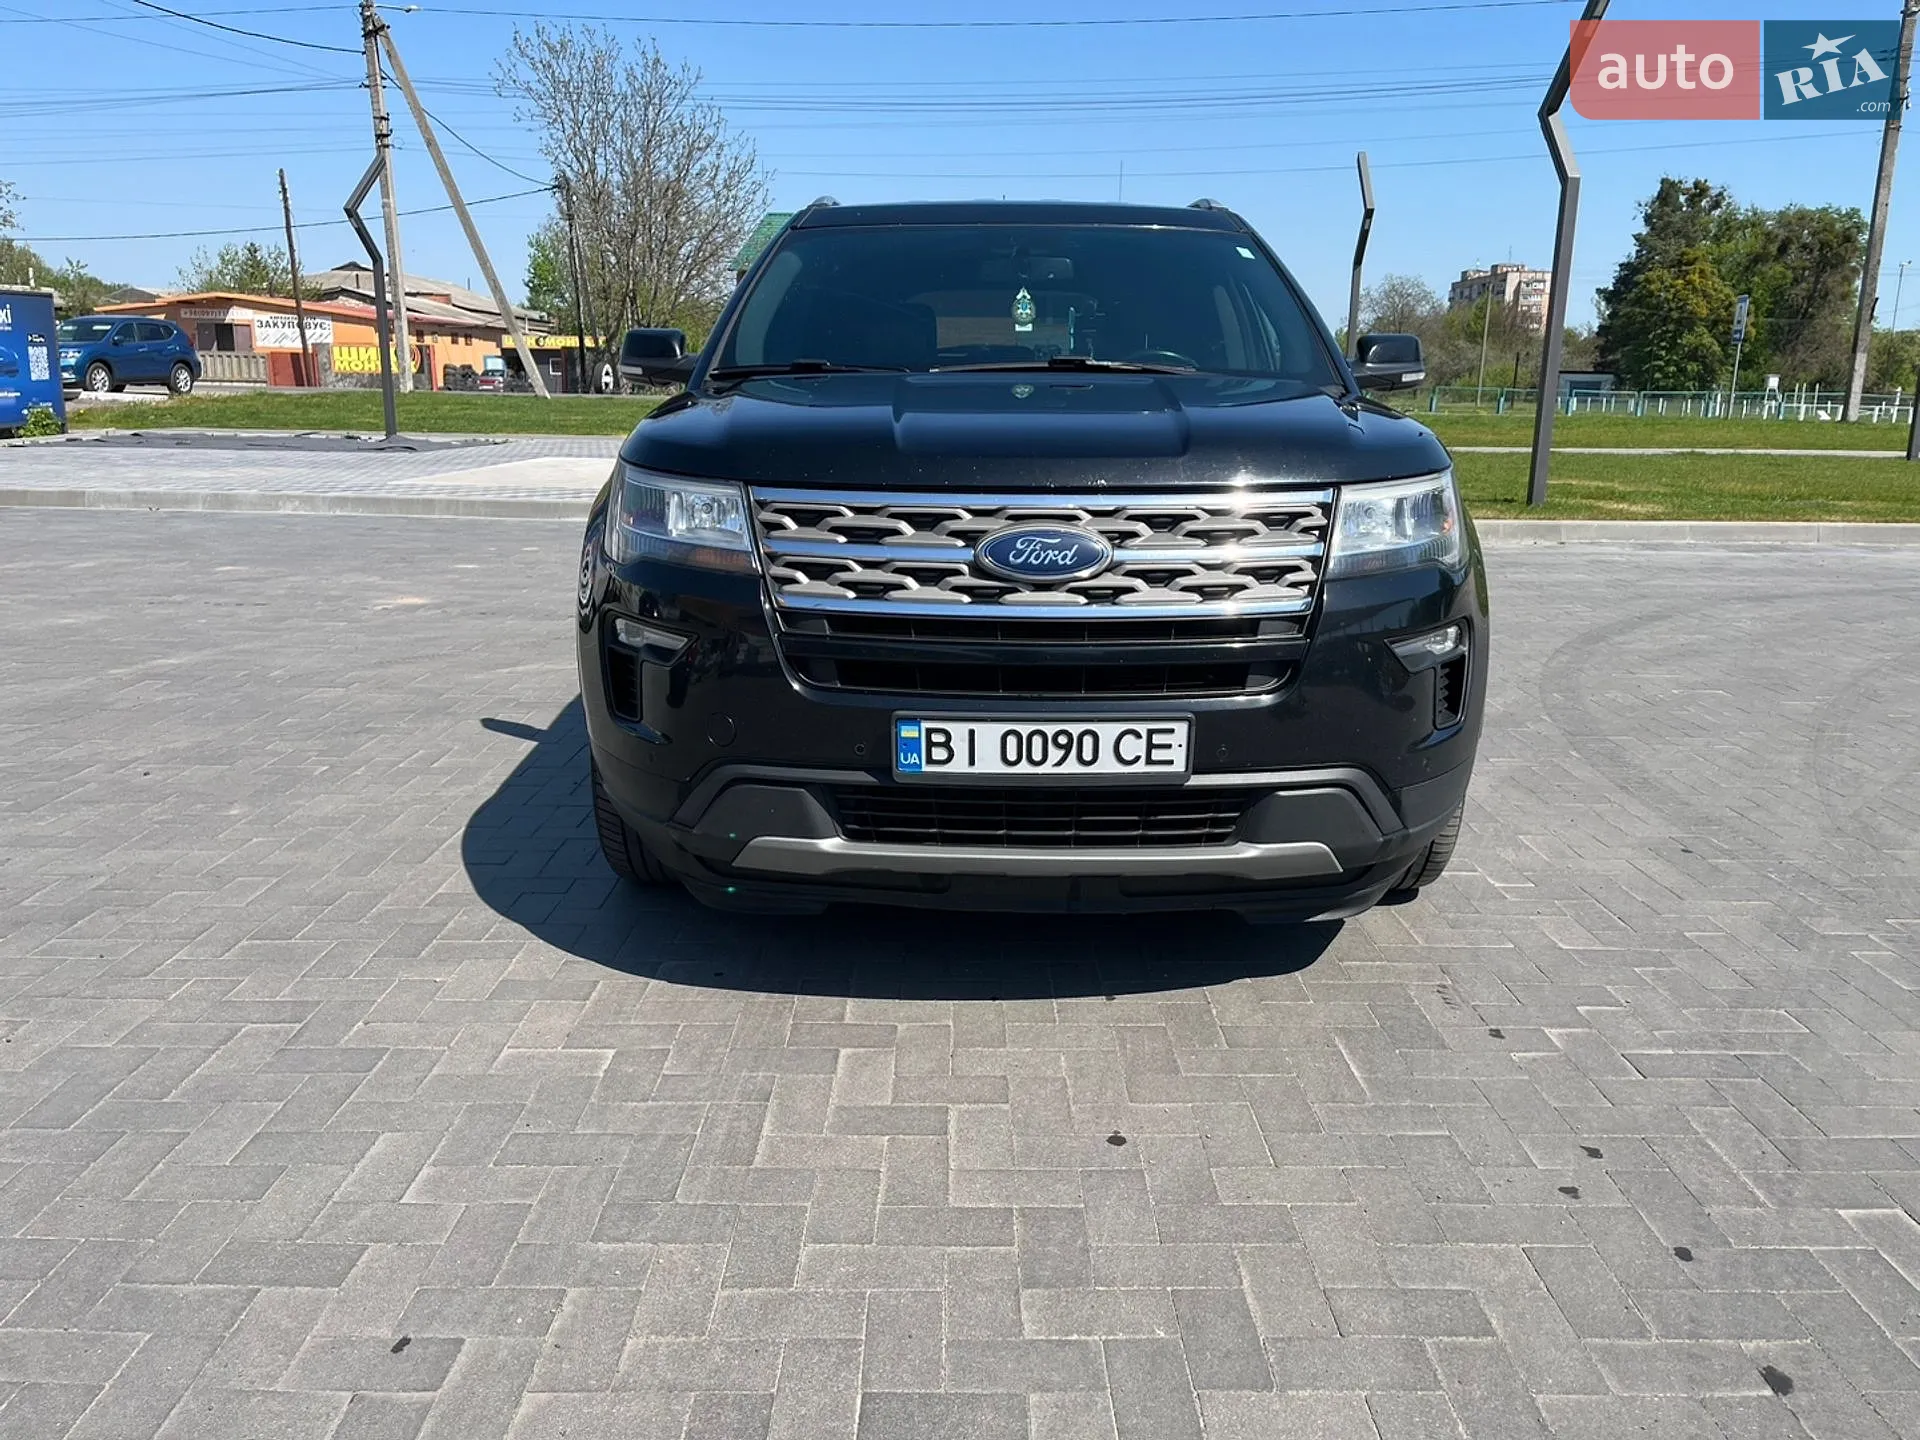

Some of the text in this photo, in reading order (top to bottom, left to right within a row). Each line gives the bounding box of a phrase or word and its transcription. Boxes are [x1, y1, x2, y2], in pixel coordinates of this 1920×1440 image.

[256, 319, 331, 331] ЗАКУПВУЄ:
[1009, 536, 1079, 565] Ford
[924, 728, 1176, 767] BI 0090 CE
[900, 752, 920, 765] UA
